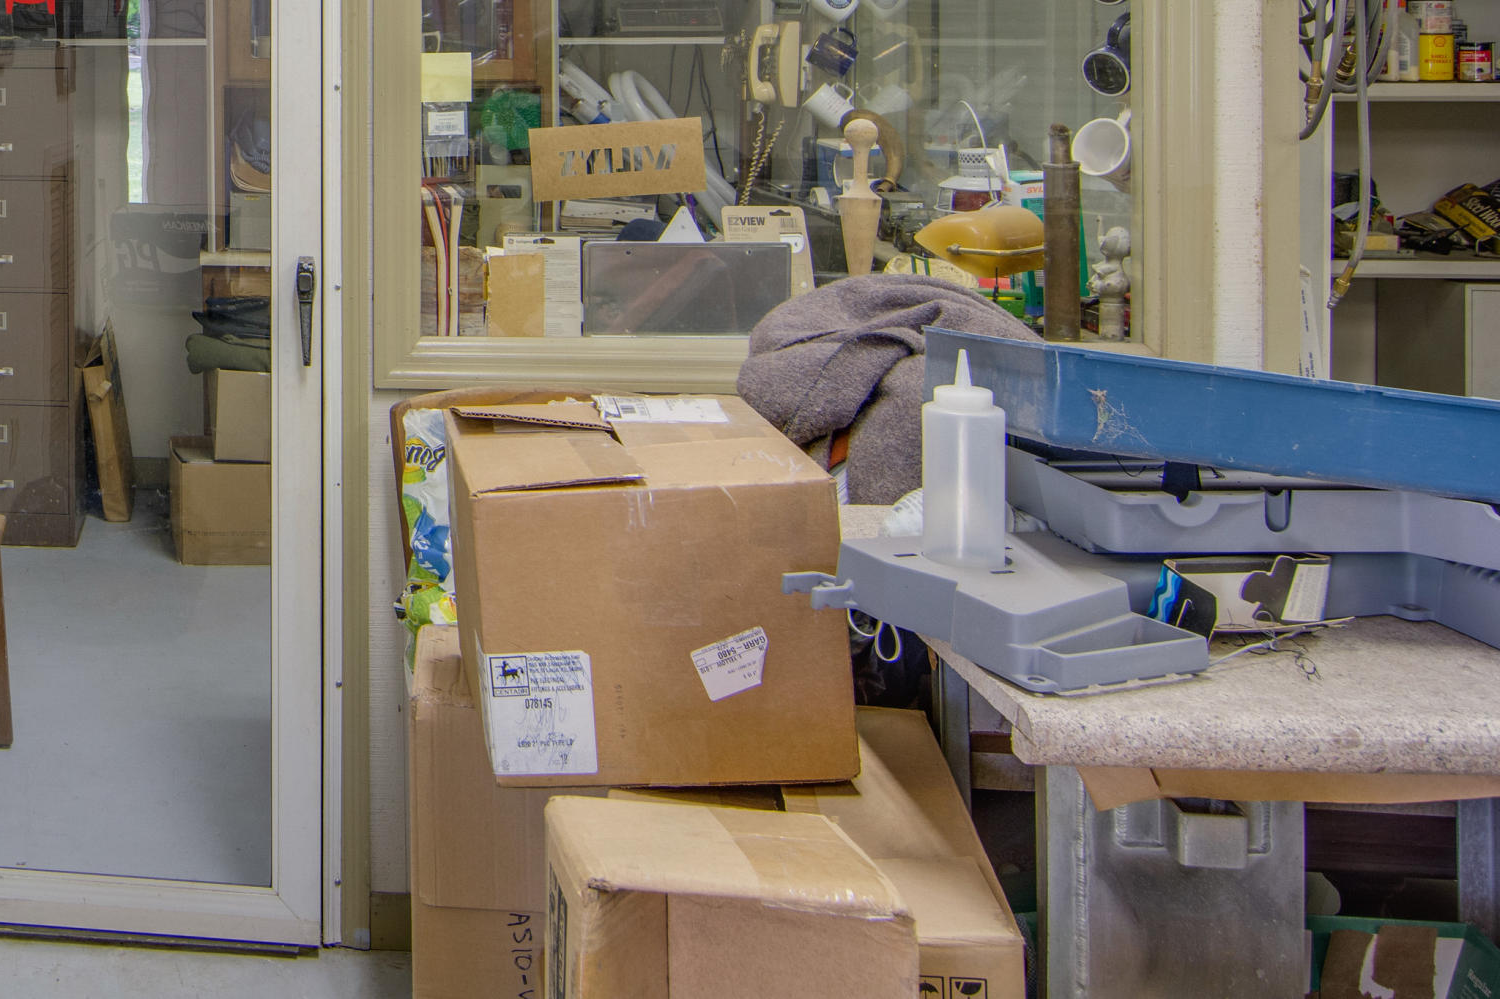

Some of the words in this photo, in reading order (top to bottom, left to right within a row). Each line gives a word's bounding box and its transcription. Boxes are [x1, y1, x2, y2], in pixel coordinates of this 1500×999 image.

[728, 216, 765, 226] EZVIEW
[743, 635, 766, 650] GARR
[717, 646, 737, 660] 5480
[524, 697, 553, 709] 078145
